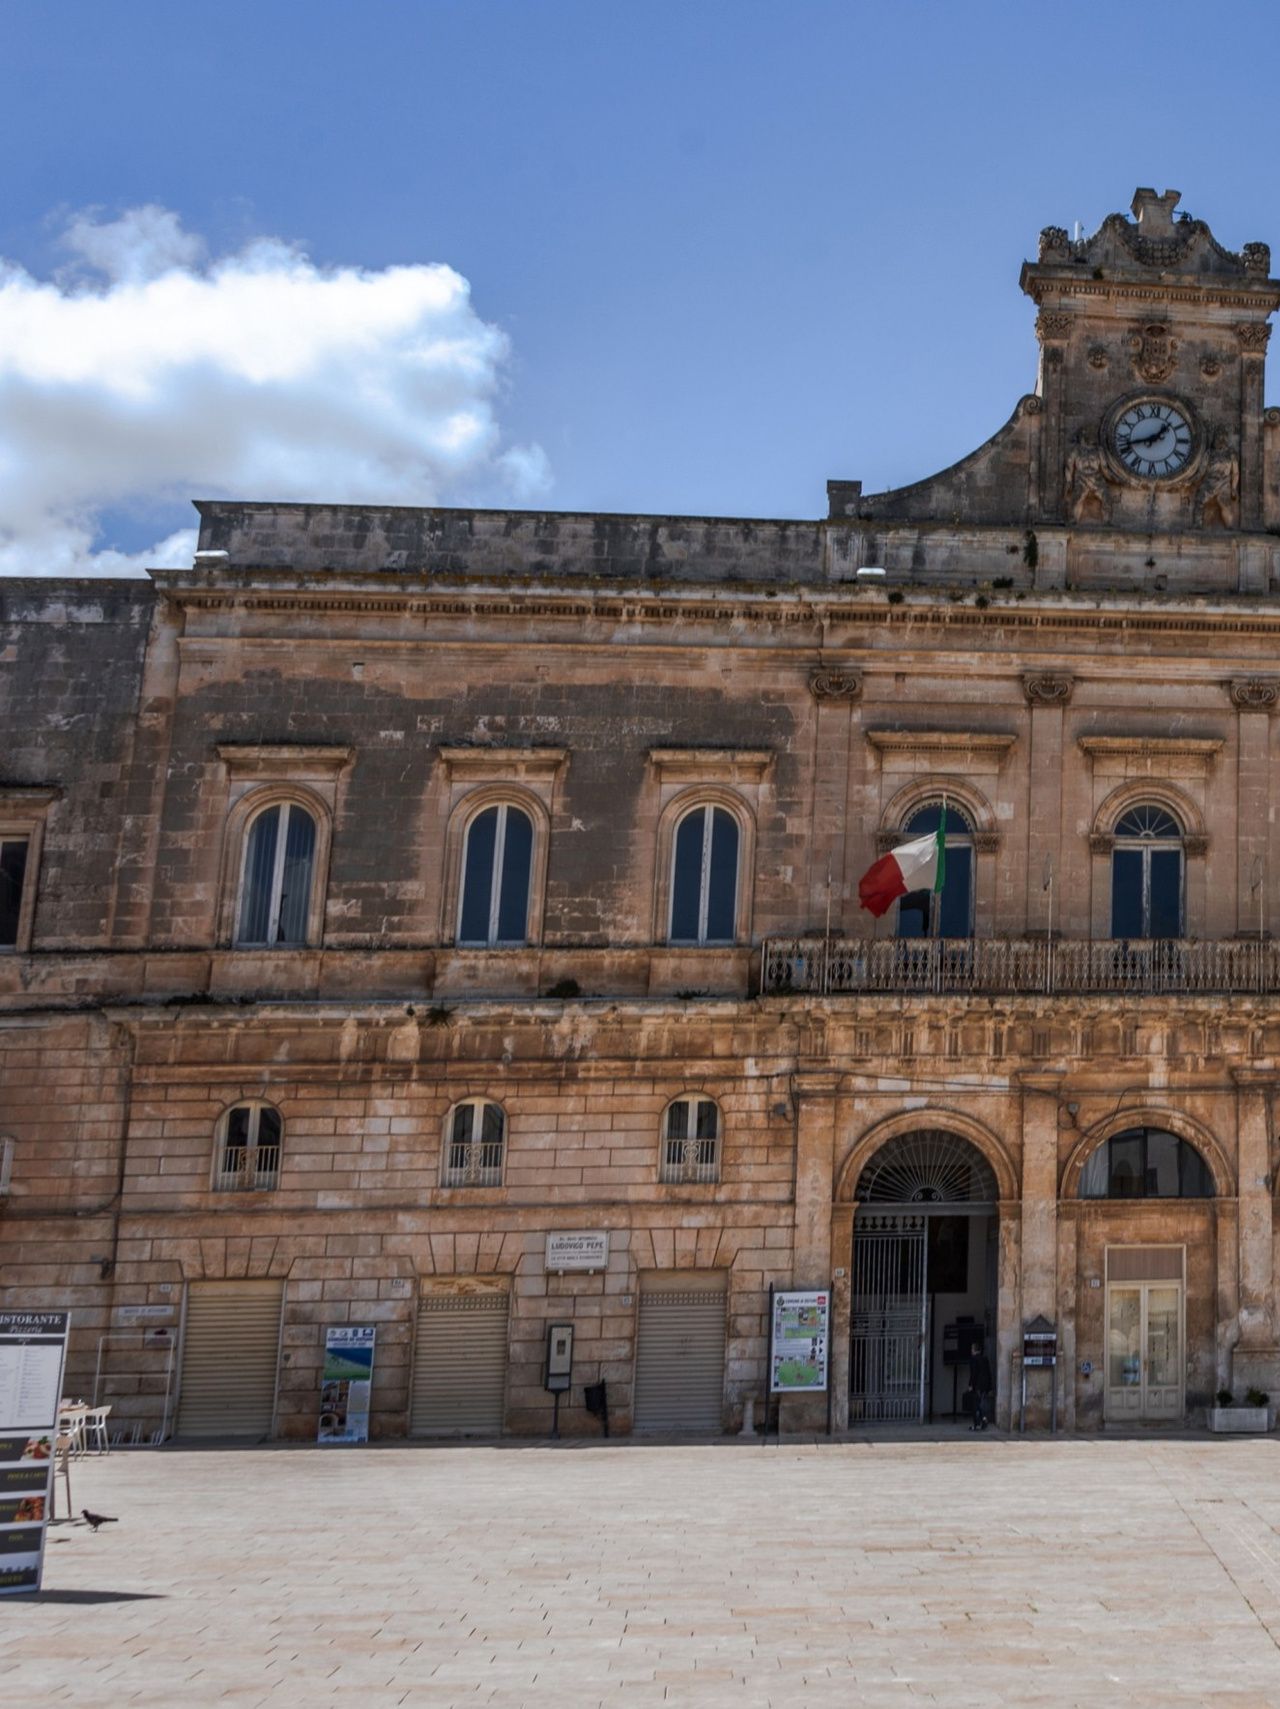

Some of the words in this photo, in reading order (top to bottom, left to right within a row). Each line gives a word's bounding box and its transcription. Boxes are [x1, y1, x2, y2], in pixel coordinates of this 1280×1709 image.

[551, 1242, 584, 1250] LUDOVICO
[586, 1241, 604, 1249] PEPE
[0, 1315, 61, 1324] ISTORANTE
